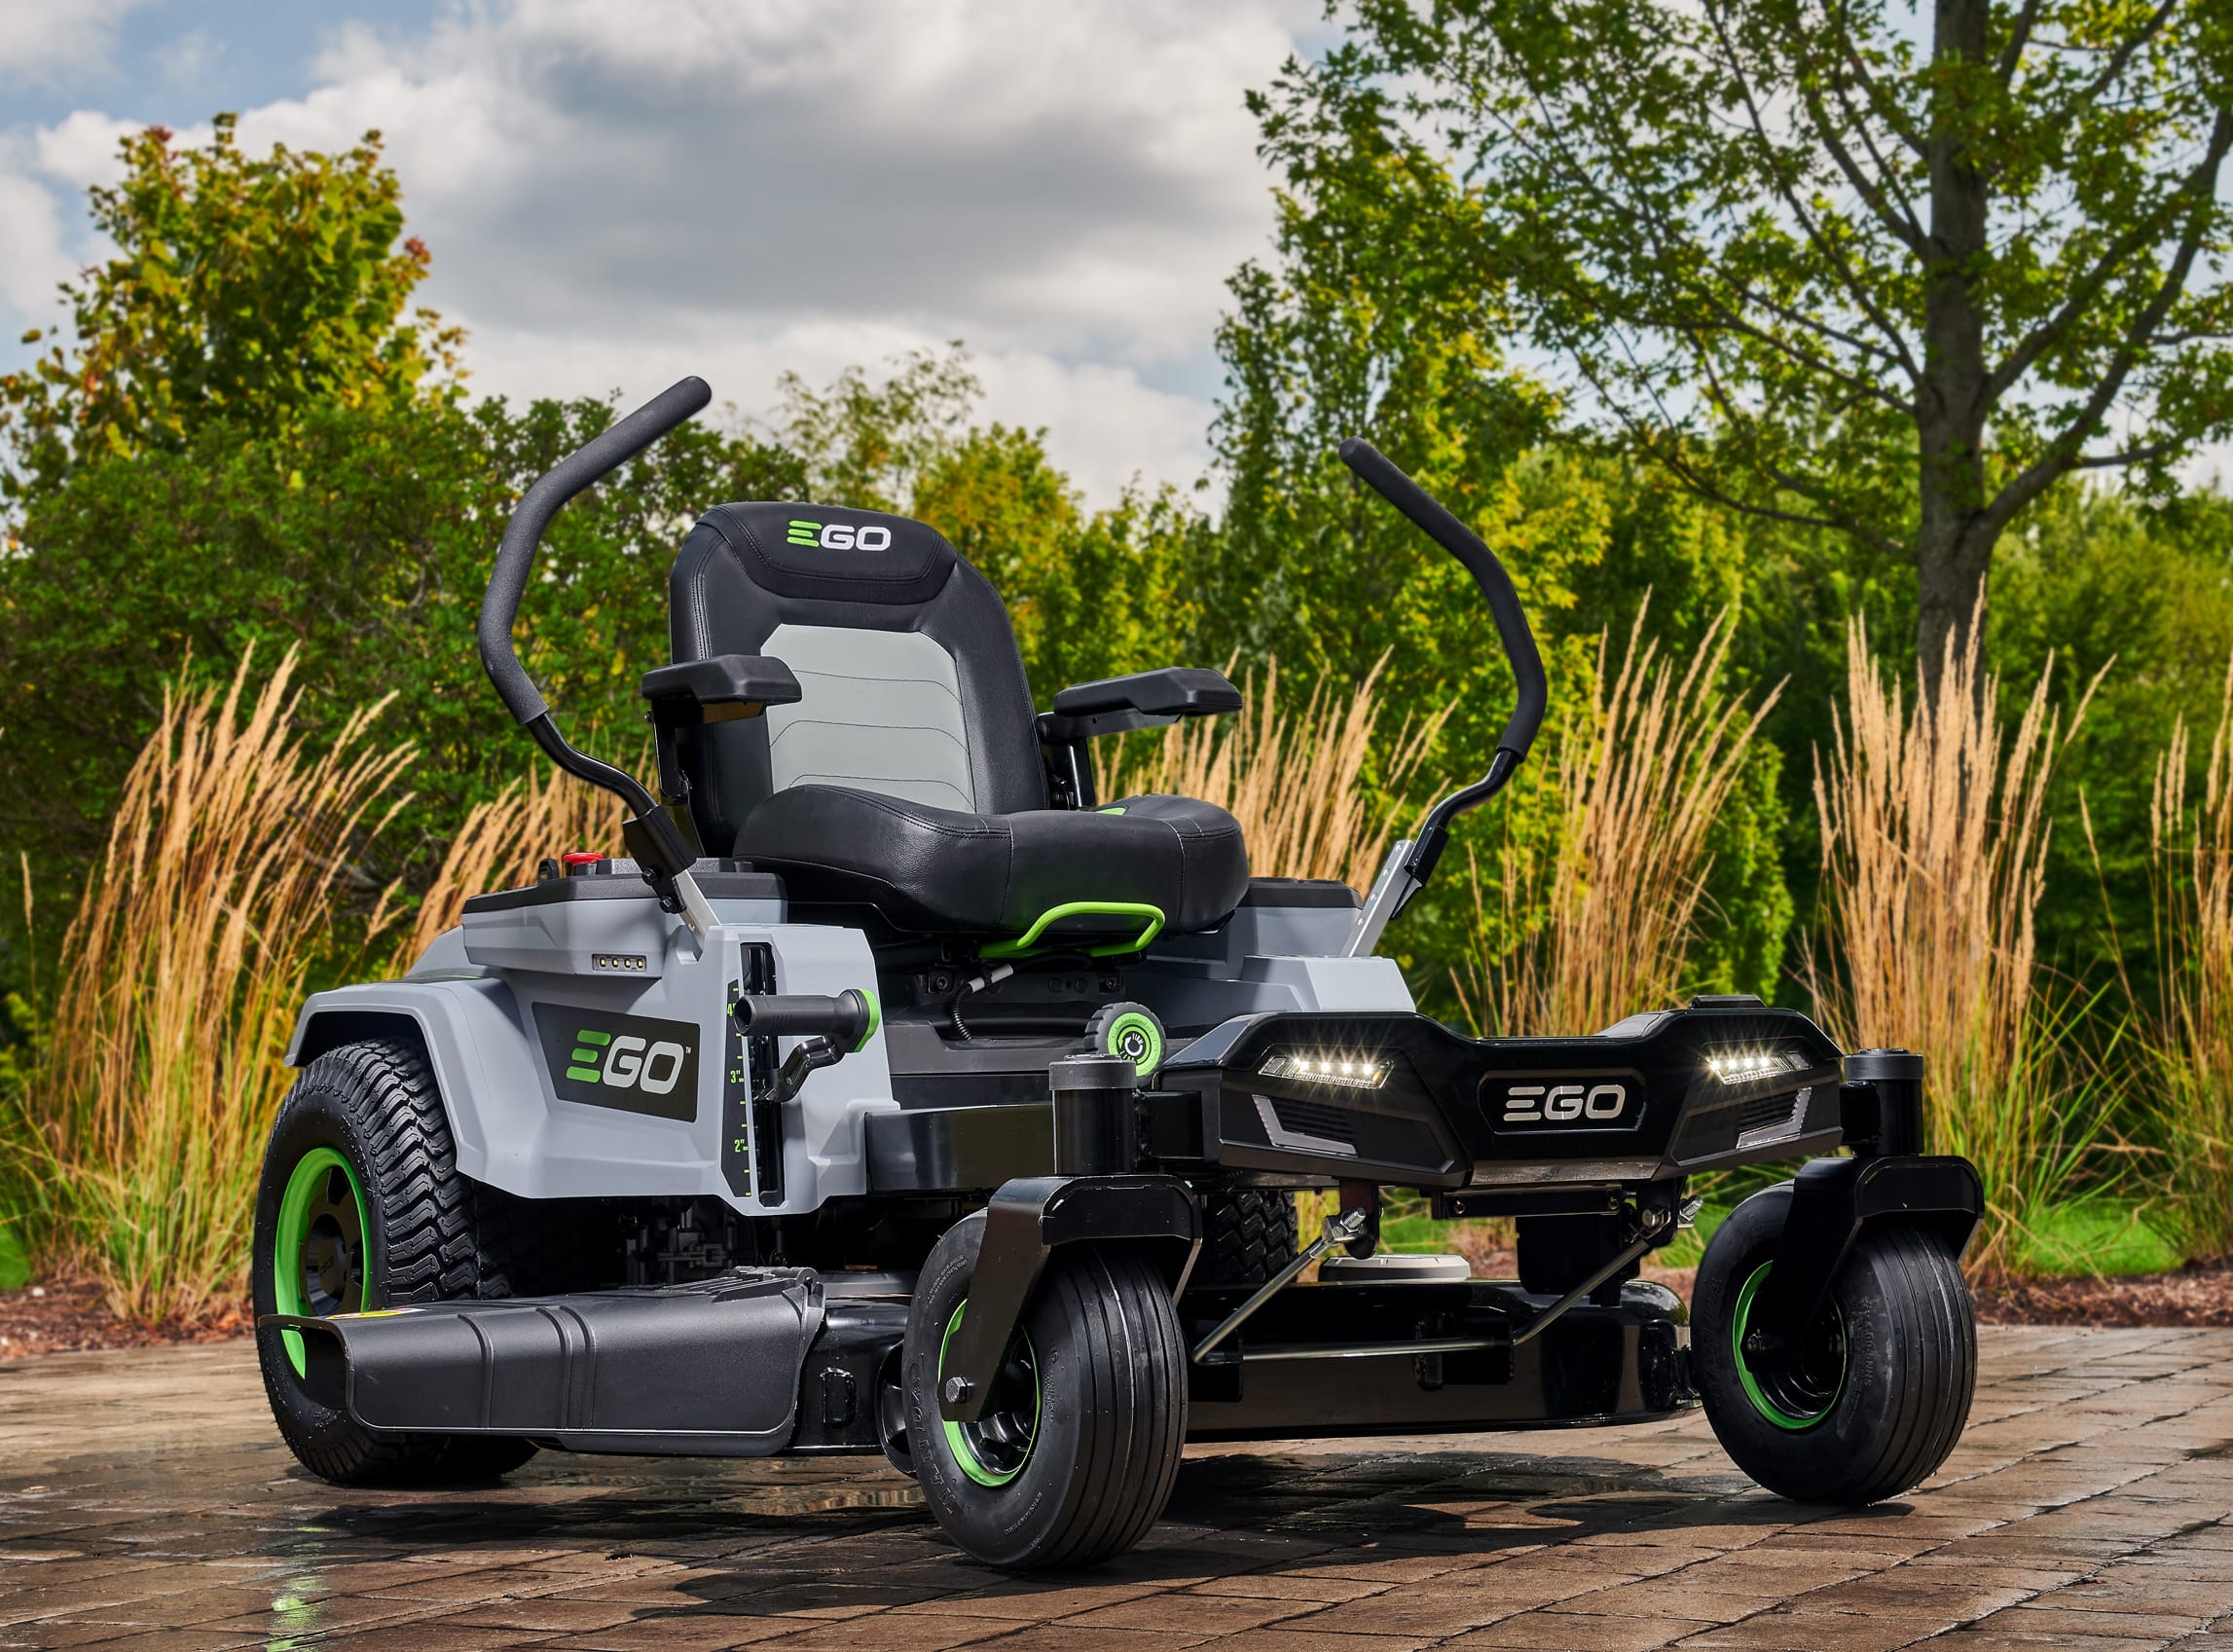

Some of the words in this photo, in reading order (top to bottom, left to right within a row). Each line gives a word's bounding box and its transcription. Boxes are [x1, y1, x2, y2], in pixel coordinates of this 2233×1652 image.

[787, 520, 892, 552] EGO
[566, 1029, 684, 1095] EGO
[1503, 1084, 1626, 1121] EGO
